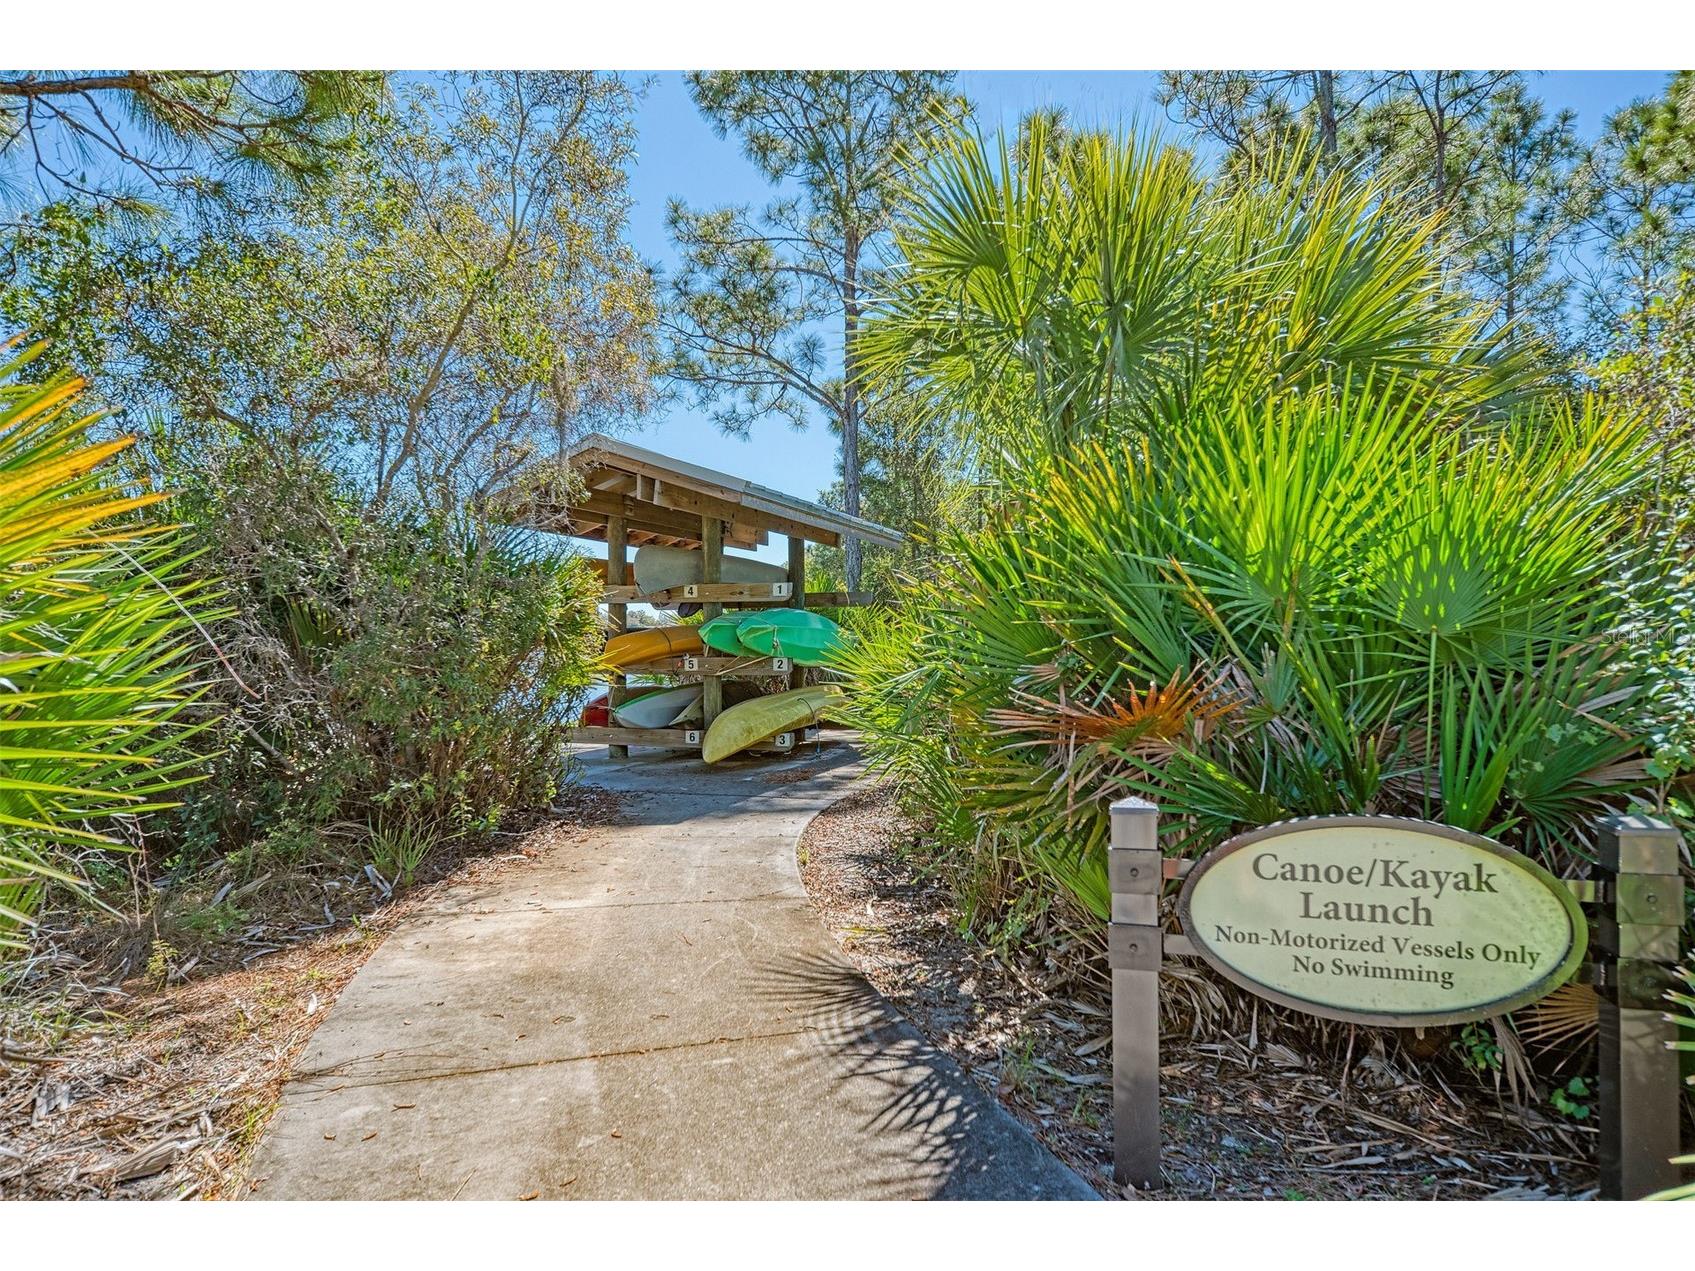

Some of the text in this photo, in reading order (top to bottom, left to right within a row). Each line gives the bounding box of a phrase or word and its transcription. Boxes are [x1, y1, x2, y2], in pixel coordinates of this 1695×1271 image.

[687, 586, 694, 596] 4
[777, 584, 783, 595] 1
[688, 659, 694, 670] 5
[777, 659, 784, 670] 2
[689, 732, 696, 742] 6
[779, 734, 786, 745] 3
[1252, 852, 1499, 899] Canoe/Kayak
[1299, 891, 1435, 927] Launch
[1214, 924, 1542, 971] Non-Motorized Vessels Only
[1292, 954, 1455, 990] No Swimming
